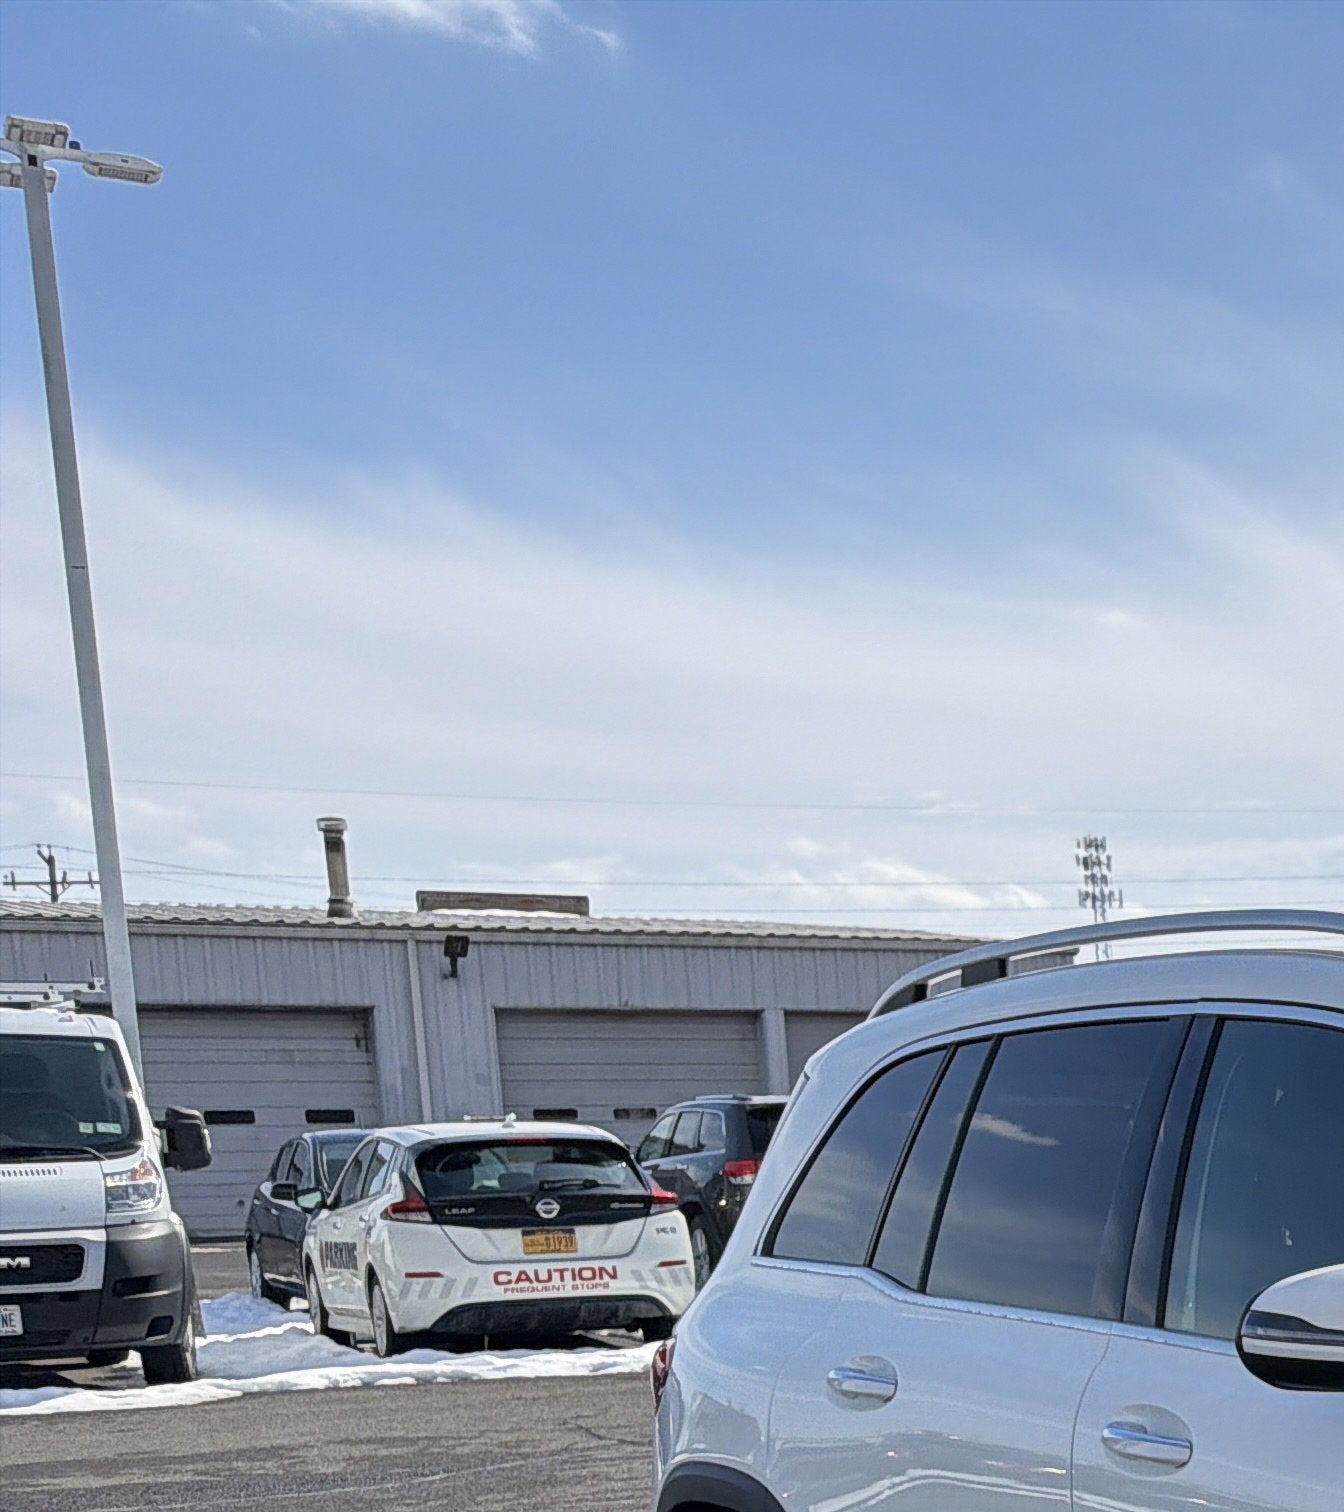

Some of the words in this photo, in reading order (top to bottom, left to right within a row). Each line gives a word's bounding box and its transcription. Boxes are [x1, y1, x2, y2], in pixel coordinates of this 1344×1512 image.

[493, 1265, 618, 1286] CAUTION
[503, 1284, 567, 1295] FREQUENT
[571, 1281, 610, 1291] STOPS
